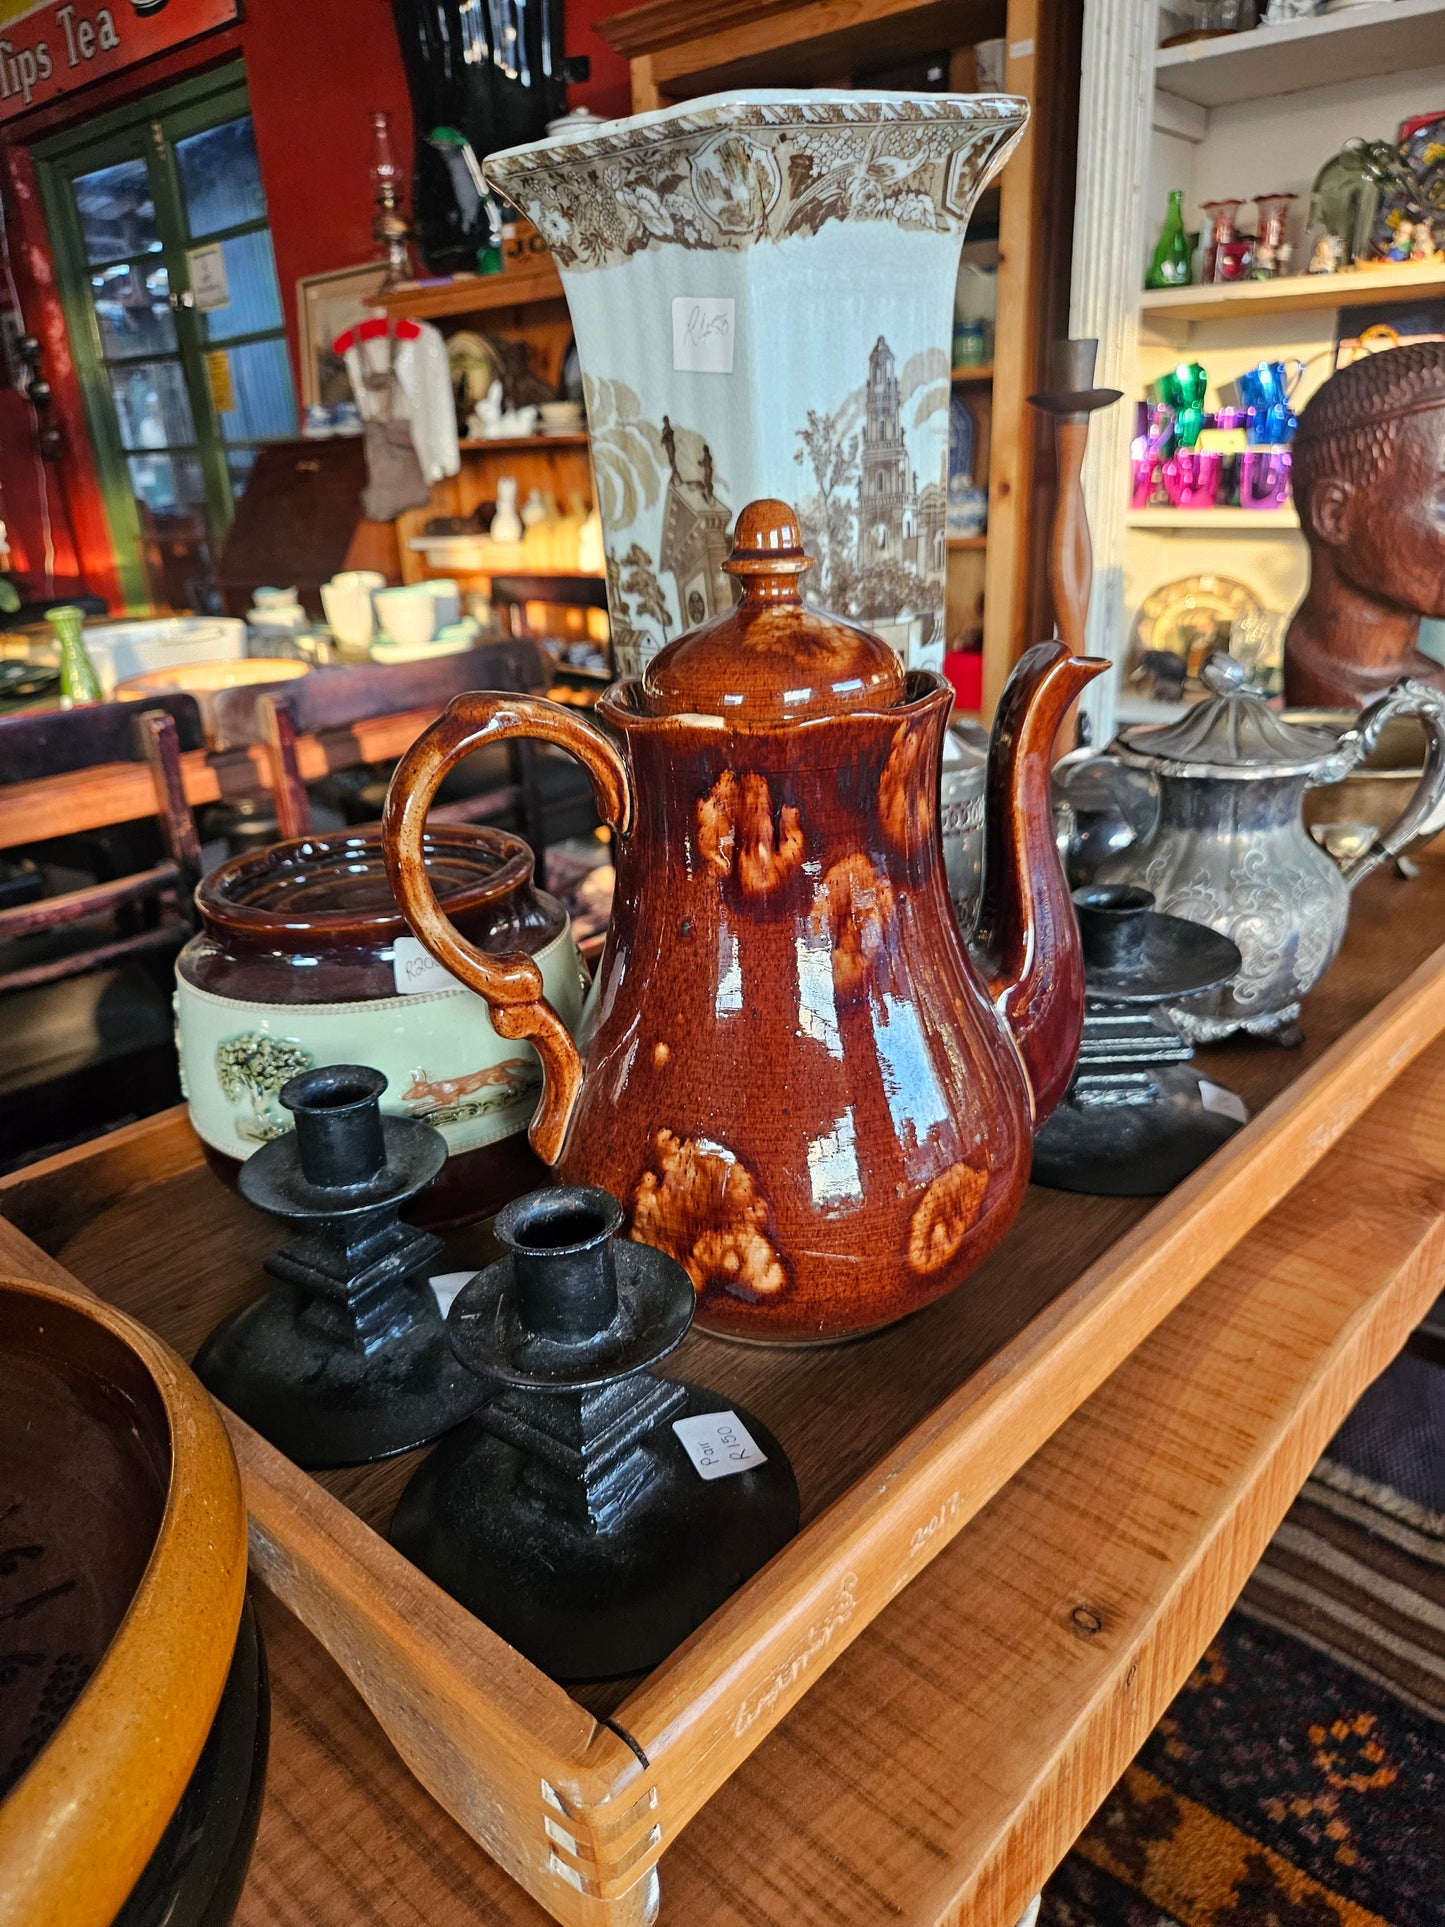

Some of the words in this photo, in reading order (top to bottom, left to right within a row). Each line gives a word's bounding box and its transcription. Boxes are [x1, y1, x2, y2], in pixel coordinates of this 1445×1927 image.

[56, 4, 121, 67] Tea
[405, 956, 441, 982] R20
[697, 1440, 720, 1467] Pair
[716, 1425, 753, 1462] R150
